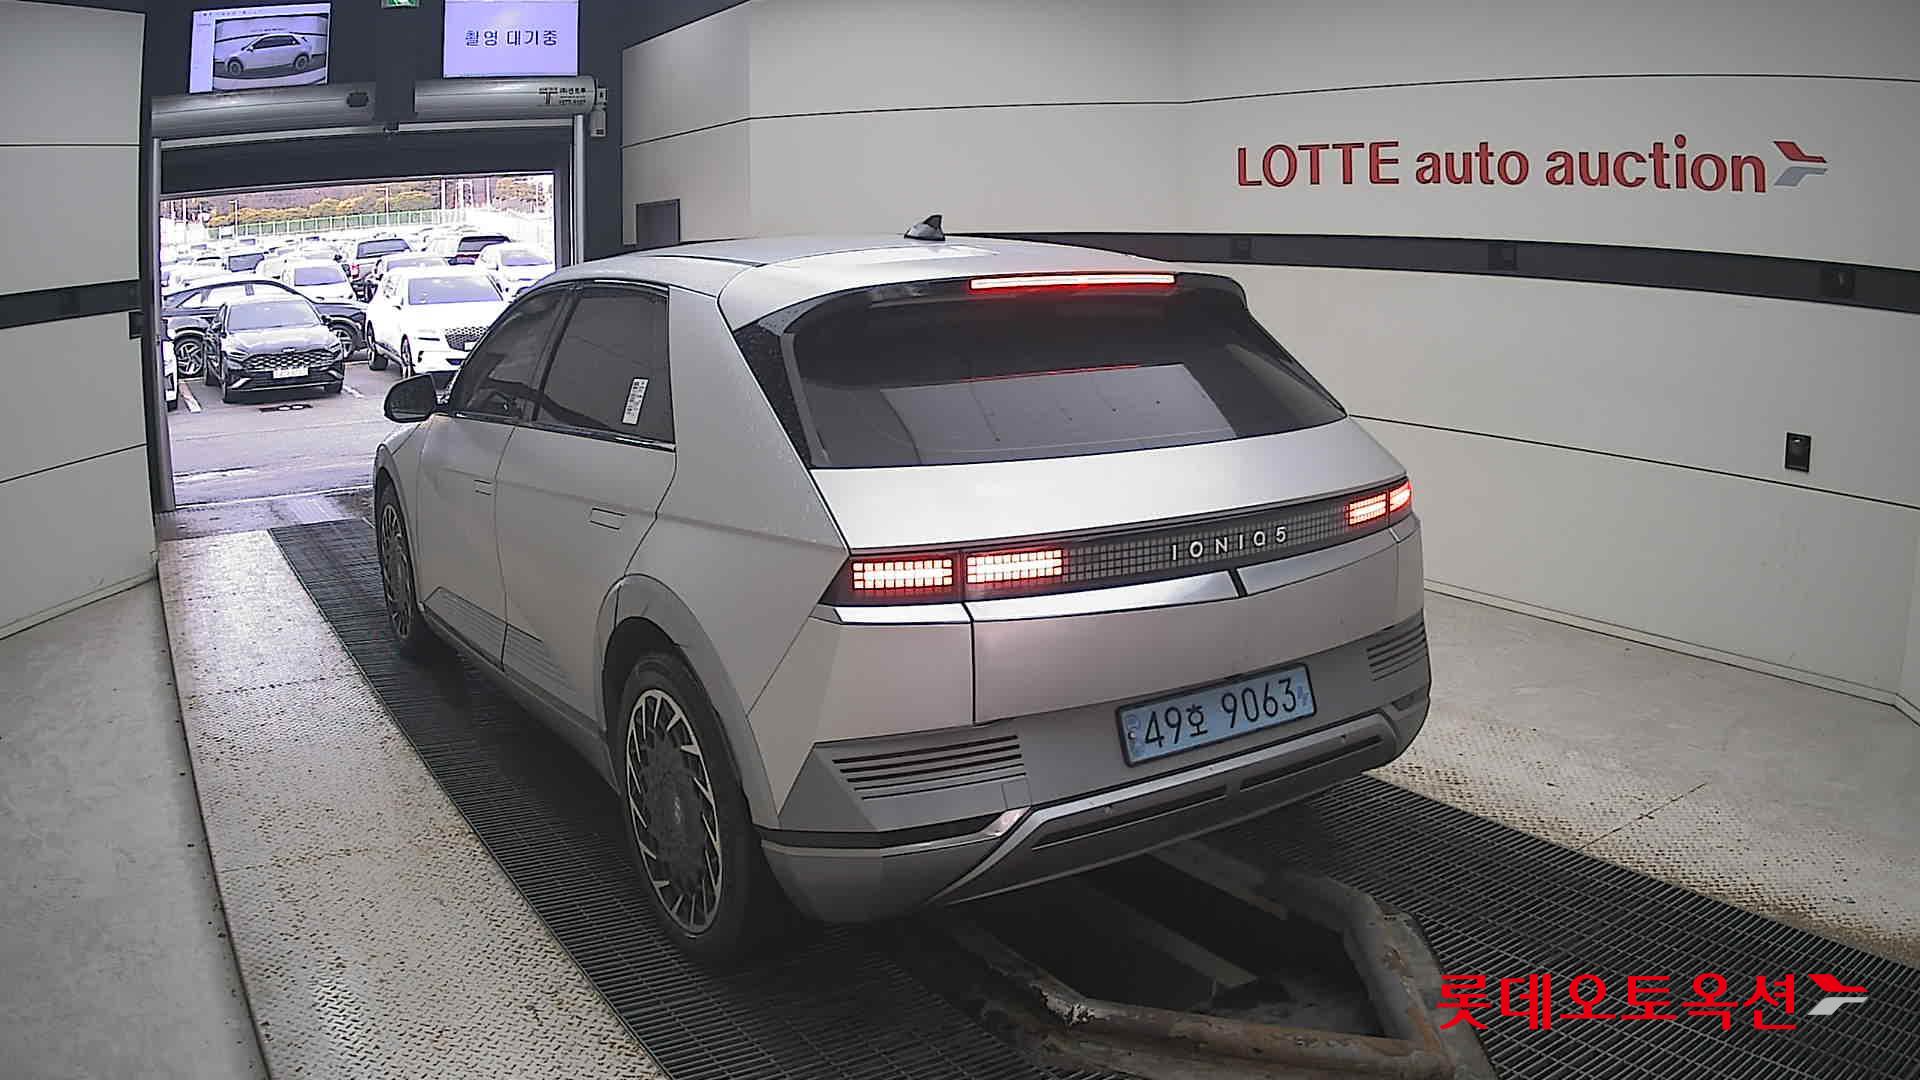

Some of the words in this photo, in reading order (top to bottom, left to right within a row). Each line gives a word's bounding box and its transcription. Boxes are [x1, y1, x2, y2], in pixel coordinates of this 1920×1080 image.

[465, 30, 498, 46] 촬영
[506, 30, 557, 46] 대기중
[1237, 141, 1400, 187] LOTTE
[1415, 142, 1530, 185] auto
[1545, 134, 1767, 193] auction
[1144, 704, 1209, 748] 49호
[1221, 676, 1297, 729] 9063
